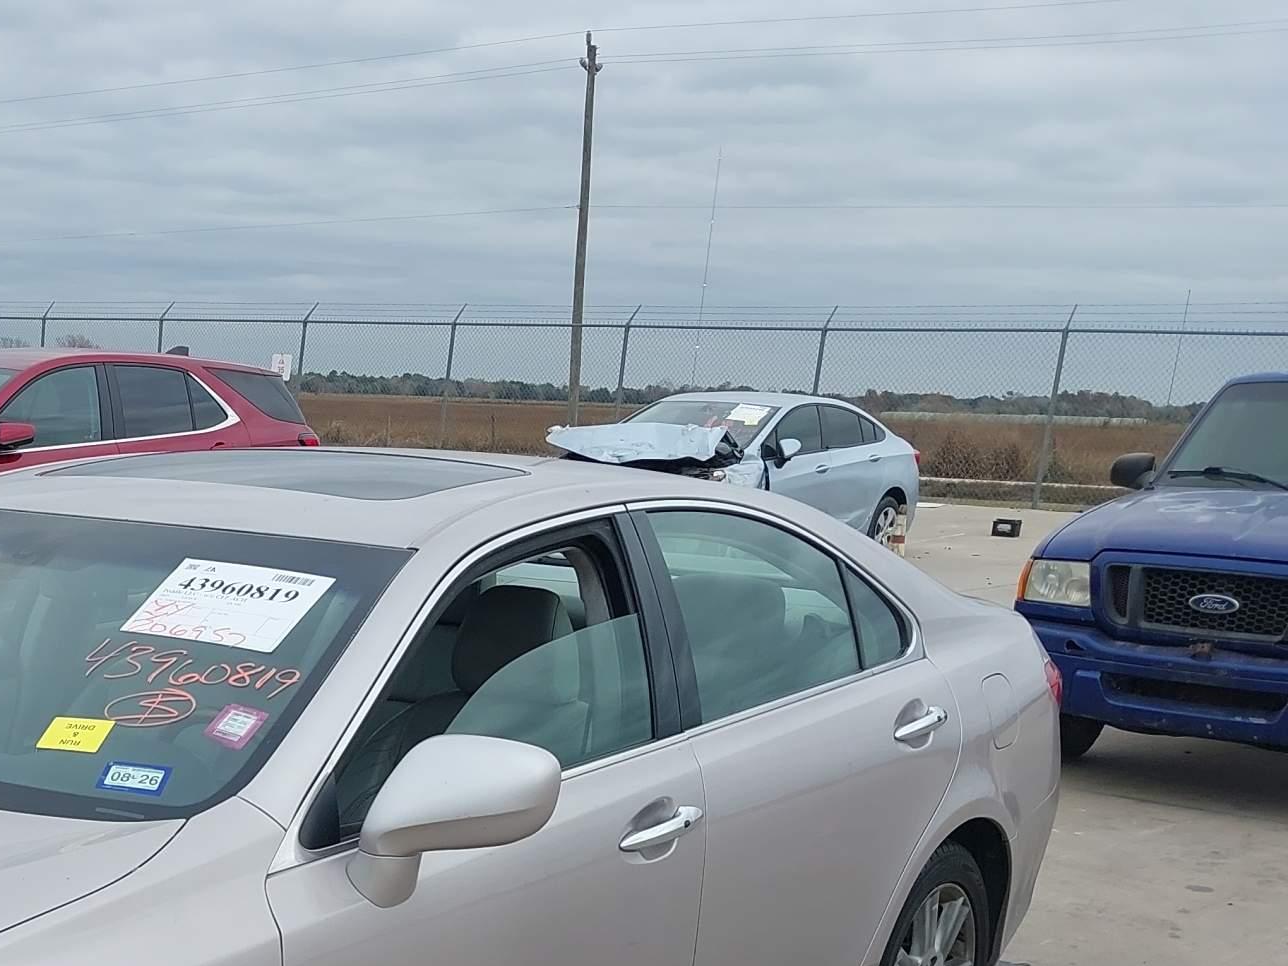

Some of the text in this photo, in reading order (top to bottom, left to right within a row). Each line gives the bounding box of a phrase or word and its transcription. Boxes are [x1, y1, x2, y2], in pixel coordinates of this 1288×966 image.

[177, 576, 300, 604] 43960819
[1198, 596, 1229, 611] Ford
[84, 637, 302, 700] 43960819
[64, 722, 97, 731] DRIVE
[58, 738, 81, 747] RUN
